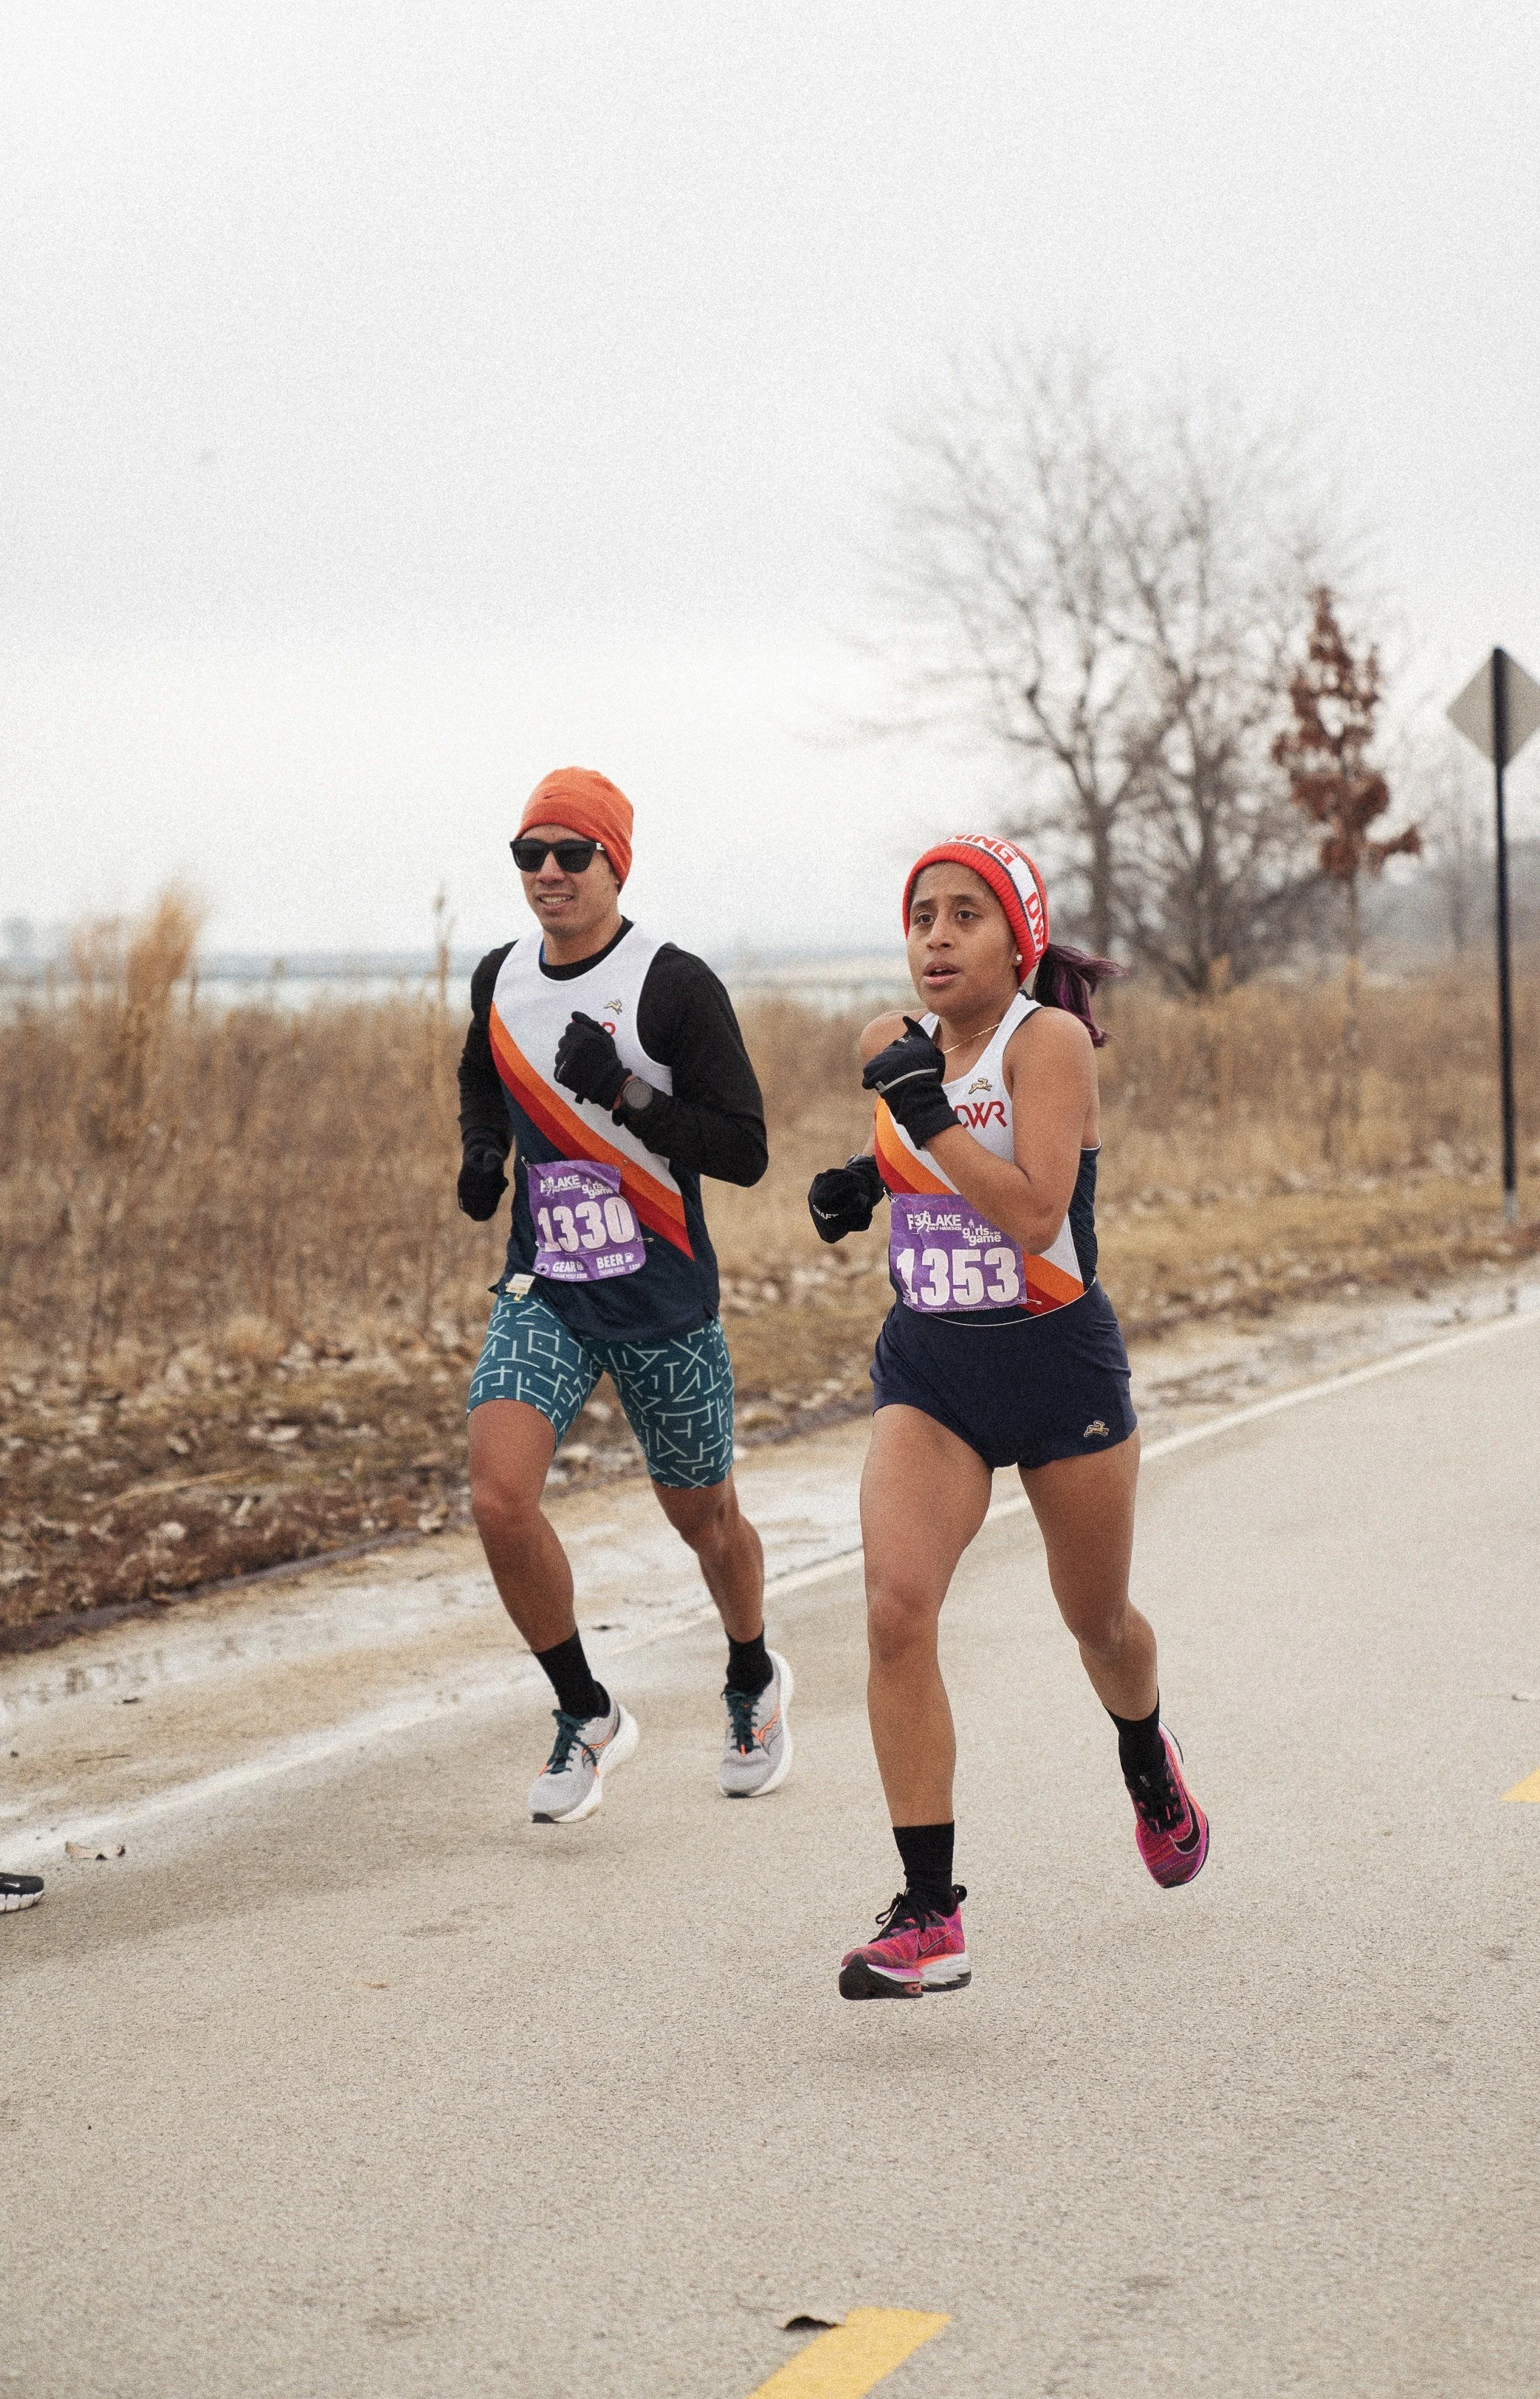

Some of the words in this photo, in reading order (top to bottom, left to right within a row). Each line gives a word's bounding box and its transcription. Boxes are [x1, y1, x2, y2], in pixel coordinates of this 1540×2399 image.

[588, 1187, 613, 1199] game
[537, 1197, 635, 1252] 1330
[969, 1234, 1002, 1246] game
[552, 1261, 577, 1273] GEAR
[597, 1254, 625, 1270] BEER
[896, 1247, 1020, 1306] 1353
